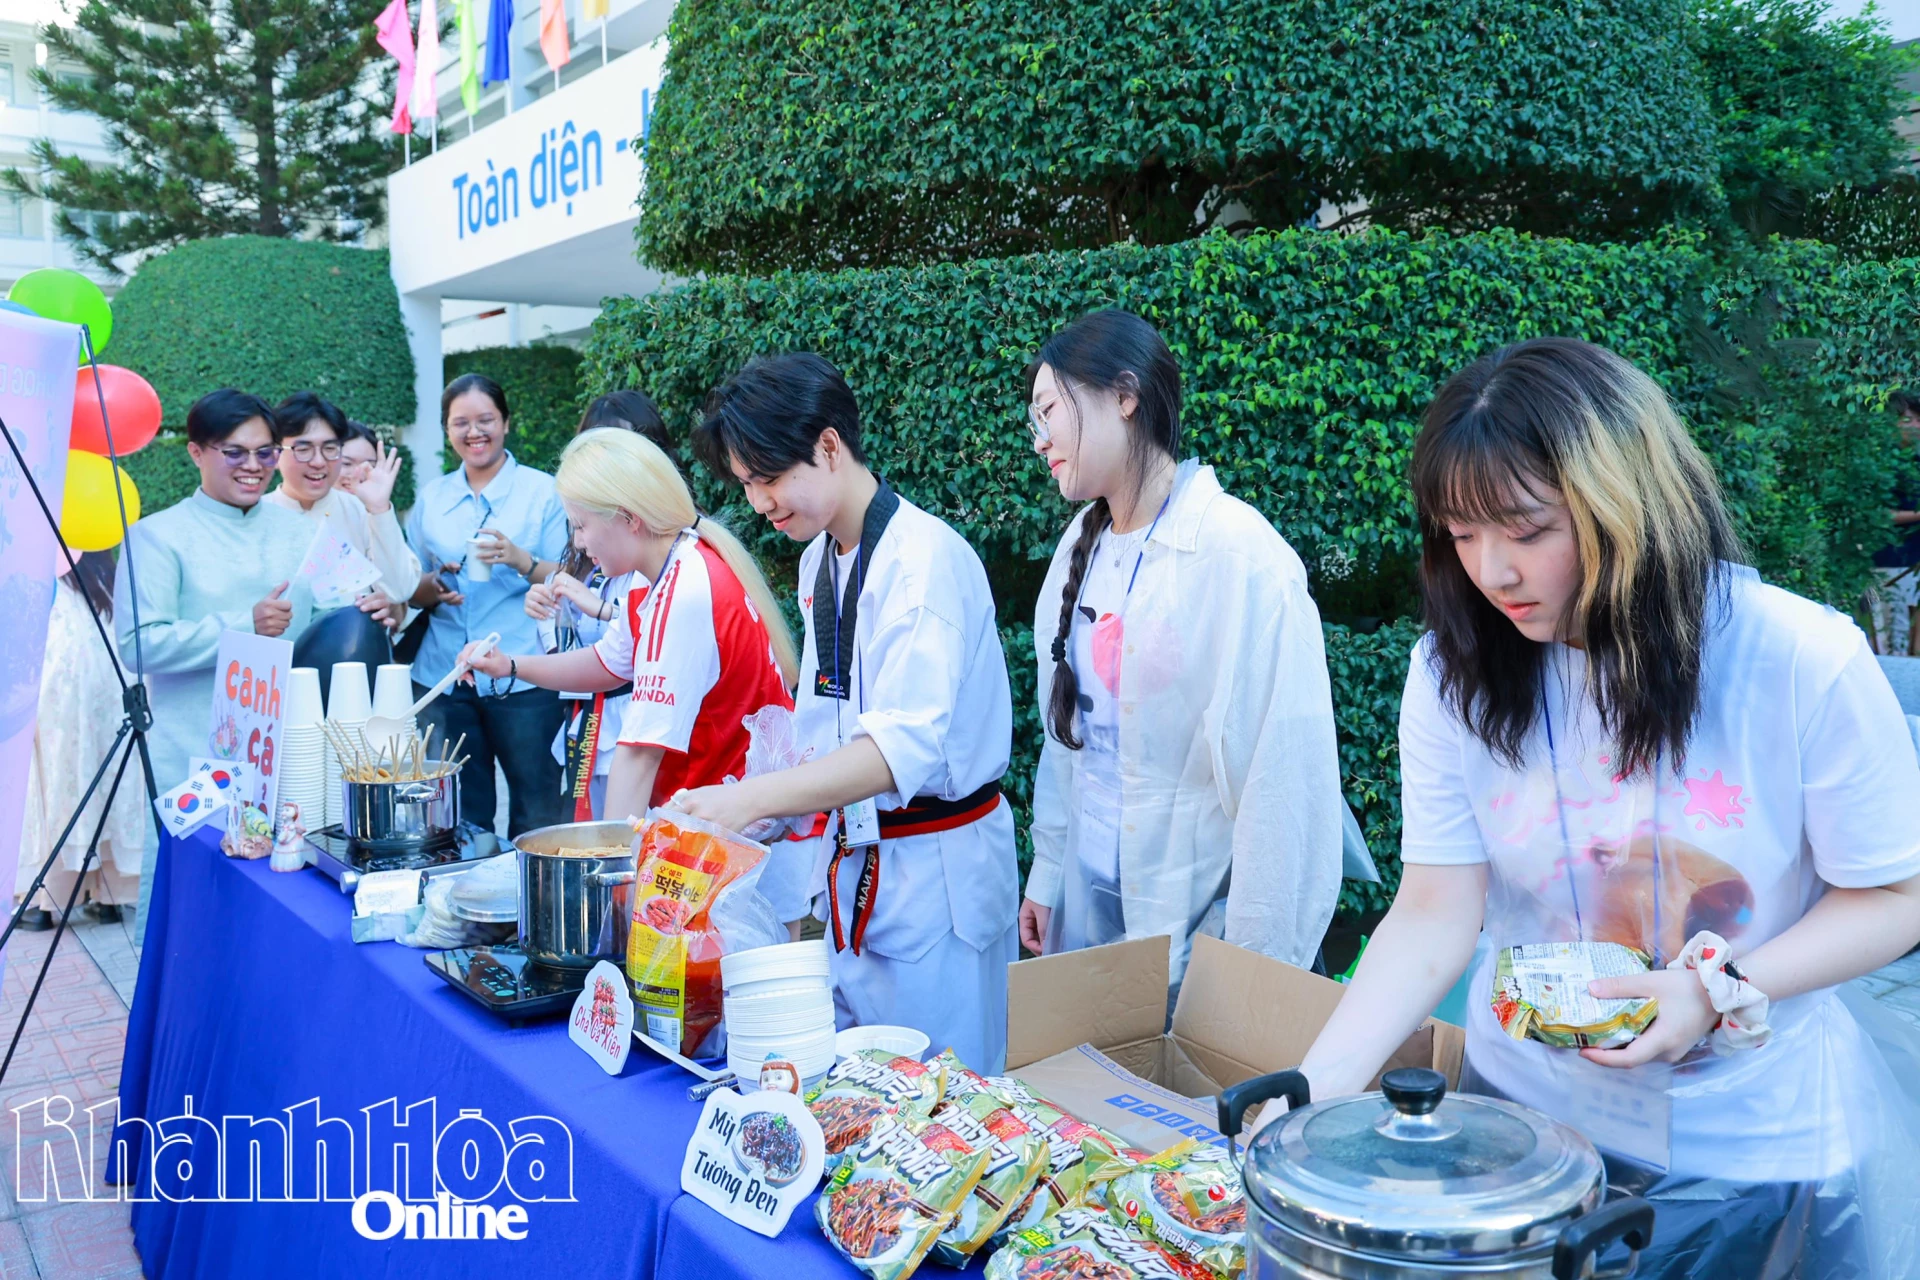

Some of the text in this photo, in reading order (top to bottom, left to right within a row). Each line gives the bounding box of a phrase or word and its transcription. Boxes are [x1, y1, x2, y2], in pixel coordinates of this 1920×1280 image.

[452, 158, 519, 240] Toàn
[529, 119, 603, 217] diện
[637, 674, 667, 689] VIIT
[601, 1028, 622, 1060] Xiên
[693, 1150, 779, 1217] Tương Đen
